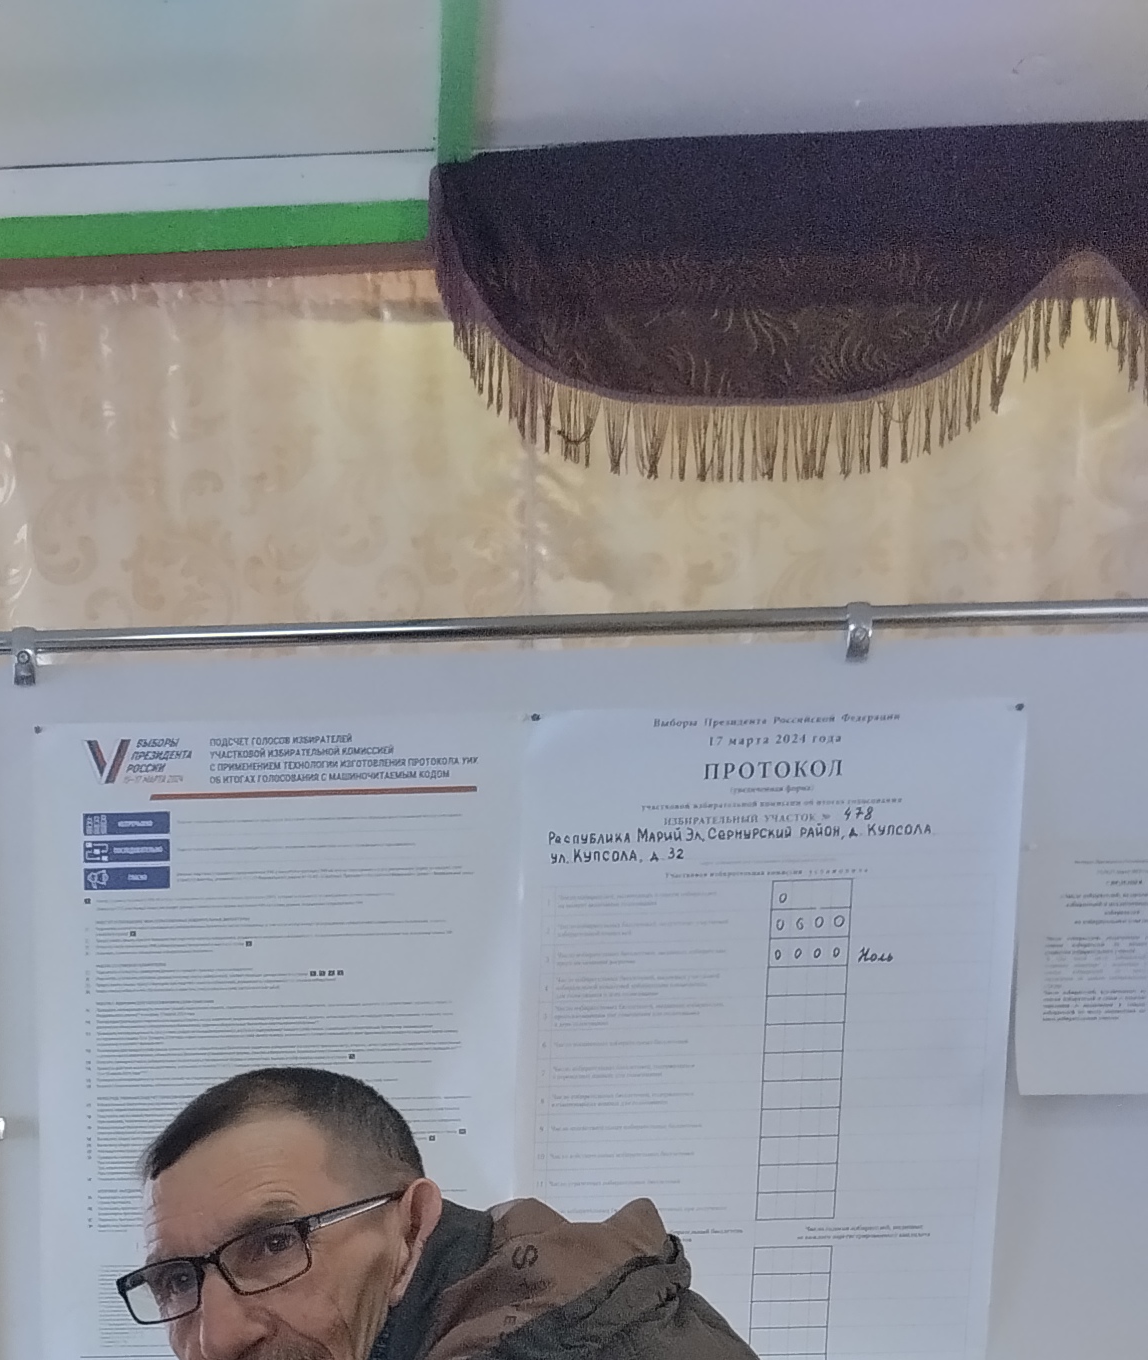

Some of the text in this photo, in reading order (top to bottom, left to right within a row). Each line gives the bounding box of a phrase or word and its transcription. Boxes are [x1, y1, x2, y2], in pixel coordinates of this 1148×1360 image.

[653, 713, 901, 729] Выборы Президента Российской Федерации
[136, 738, 180, 748] ВЫБОРЫ
[209, 733, 353, 747] ПОДСЧЕТ ГОЛОСОВ ИЗБИРАТЕЛЕЙ
[709, 734, 842, 748] 17 марта 2024 года
[130, 750, 193, 761] ПРЕЗИДЕНТА
[210, 744, 395, 760] УЧАСТКОВОЙ ИЗБИРАТЕЛЬНОЙ КОМИССИЕЙ
[126, 763, 167, 773] РОССИИ
[217, 762, 281, 772] ПРИМЕНЕНИЕМ
[283, 760, 339, 771] ТЕХНОЛОГИИ
[340, 758, 406, 769] ИЗГОТОВЛЕНИЯ
[408, 756, 460, 768] ПРОТОКОЛА
[703, 759, 844, 781] ПРОТОКОЛ
[209, 775, 221, 784] ОБ
[222, 774, 256, 784] ИТОГАХ
[257, 772, 321, 783] ГОЛОСОВАНИЯ
[328, 770, 417, 781] МАШИНОЧИТАЕМЫМ
[418, 769, 451, 780] КОДОМ
[663, 814, 759, 827] ИЗБИРАТЕЛЬНЫЙ
[763, 812, 816, 825] УЧАСТОК
[843, 805, 875, 821] 478
[667, 847, 685, 860] 32
